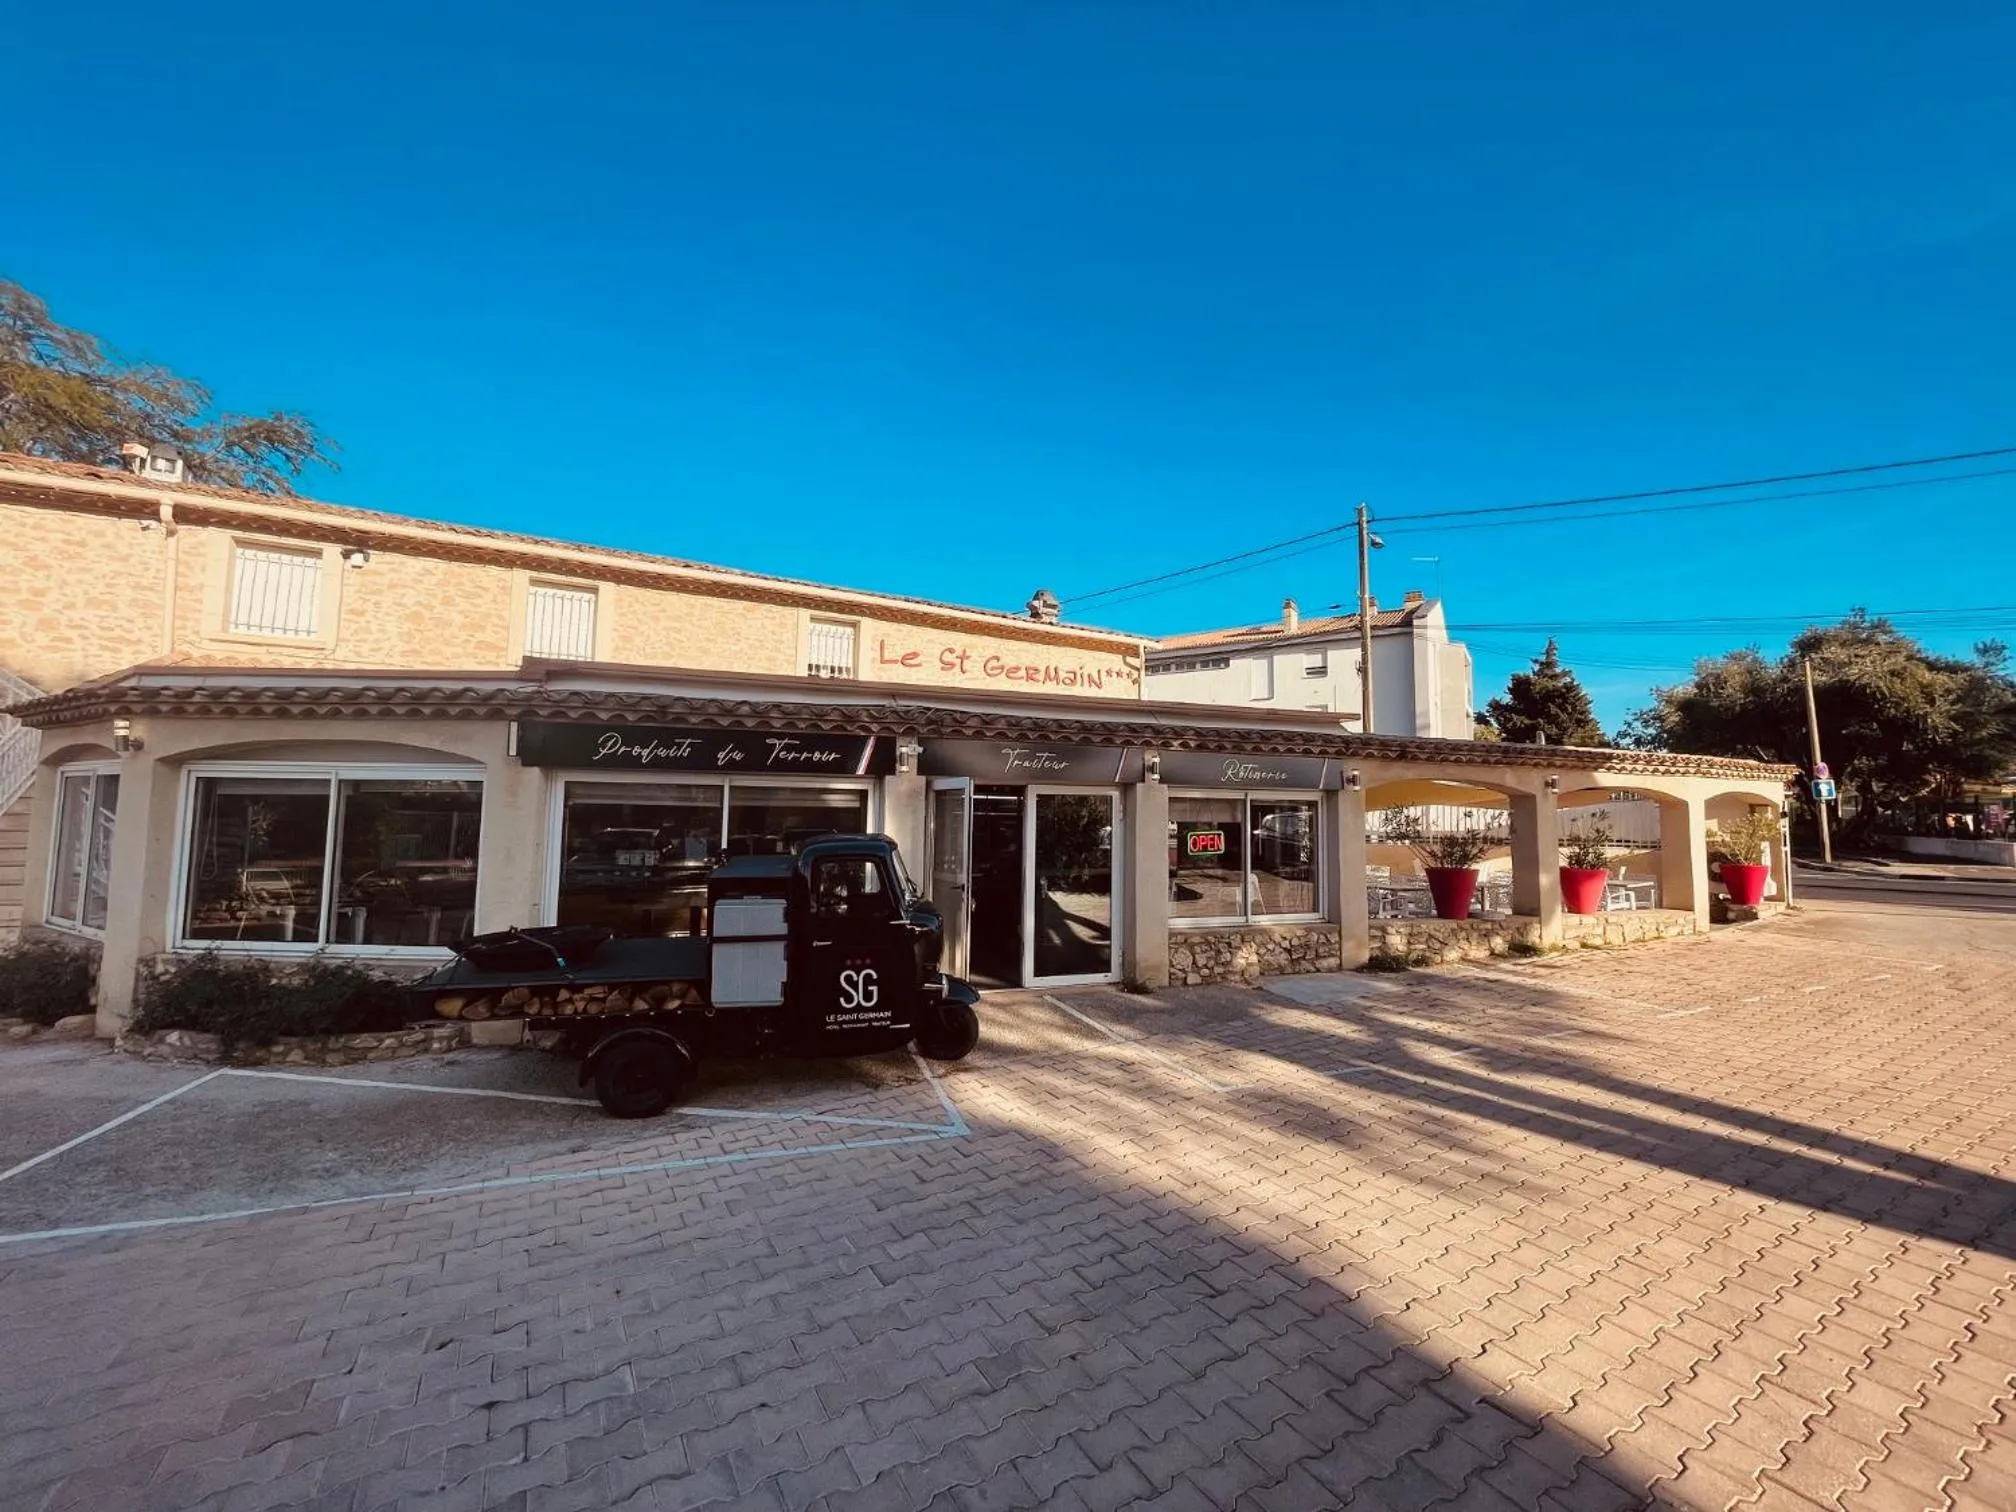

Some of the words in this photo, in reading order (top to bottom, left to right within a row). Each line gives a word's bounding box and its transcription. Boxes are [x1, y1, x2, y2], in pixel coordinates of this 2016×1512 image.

[879, 639, 922, 668] Le
[938, 647, 970, 674] St
[593, 732, 702, 763] Produits
[717, 743, 744, 766] du
[766, 738, 842, 766] Terroir
[1001, 748, 1070, 773] Traiteur
[1190, 834, 1223, 852] OPEN
[840, 969, 878, 1008] SG
[826, 1014, 836, 1022] LE
[837, 1013, 858, 1021] SAINT
